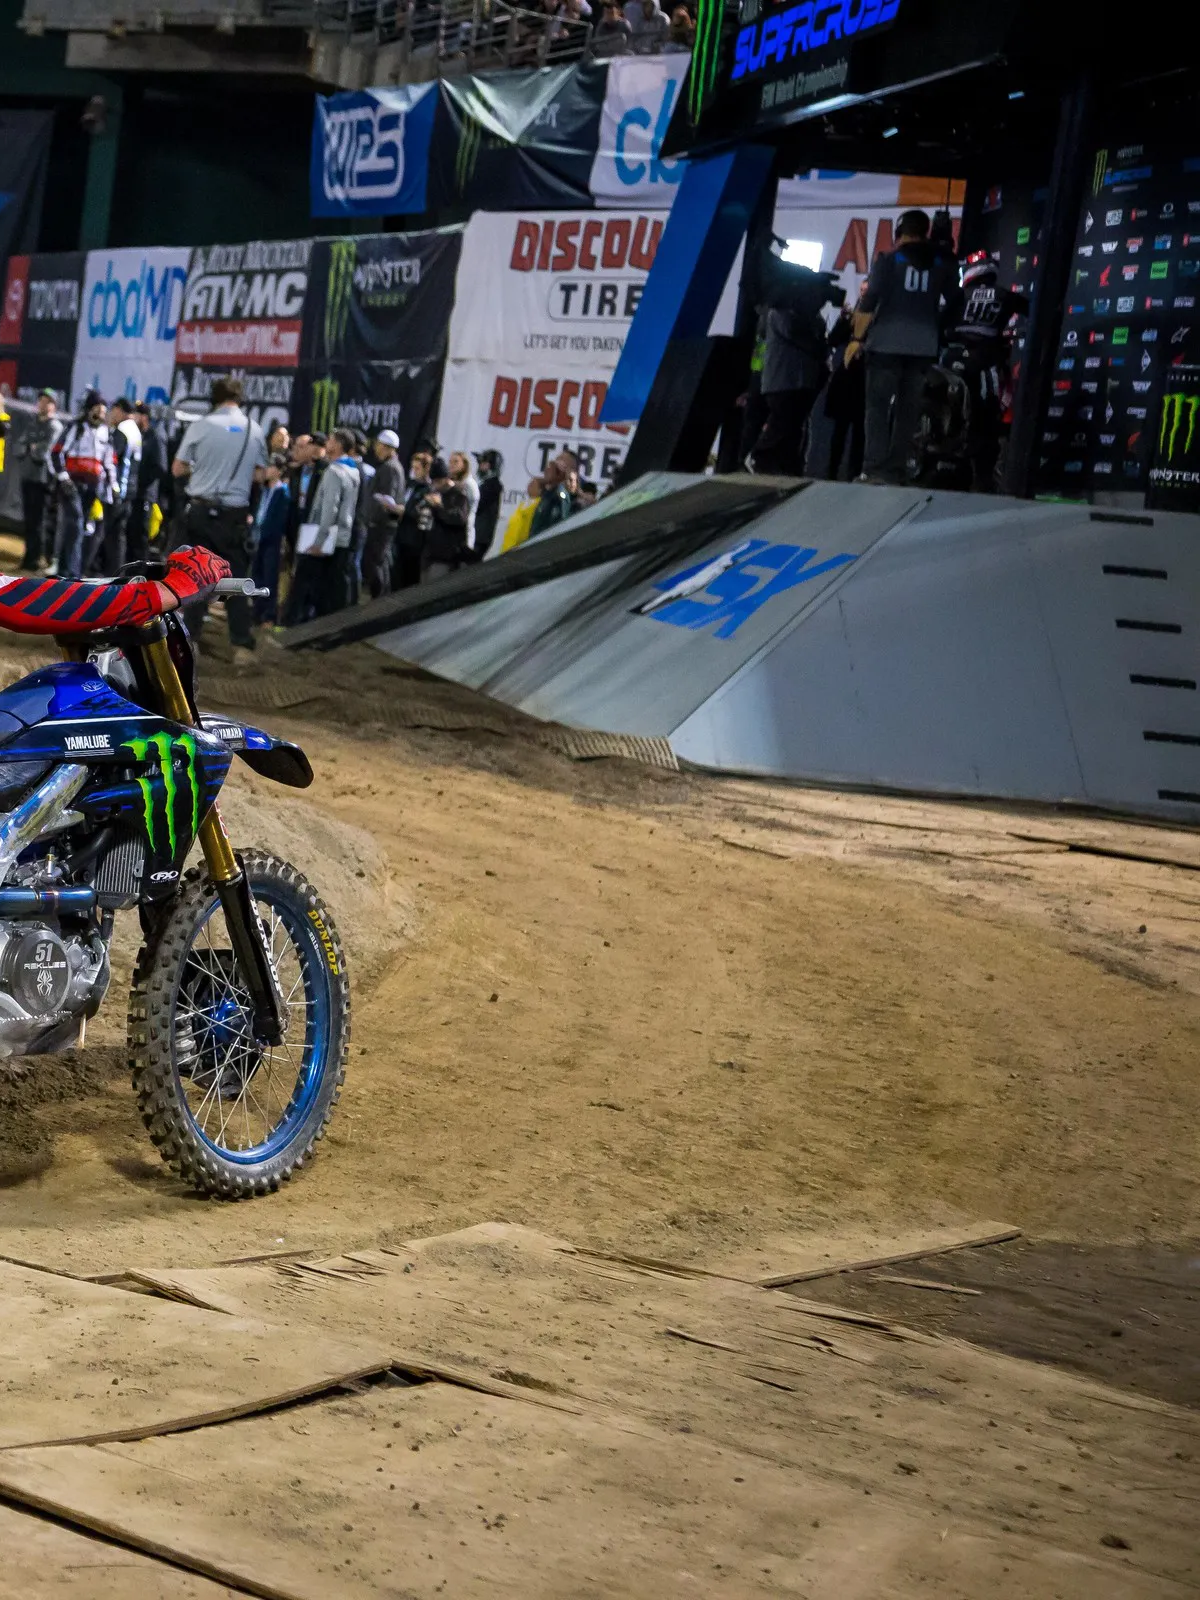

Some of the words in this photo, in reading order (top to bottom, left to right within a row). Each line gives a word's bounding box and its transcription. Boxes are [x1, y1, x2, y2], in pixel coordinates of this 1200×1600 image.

[509, 217, 664, 272] DISCOU
[89, 258, 187, 341] cbdMD
[559, 283, 644, 317] TIRE
[487, 375, 610, 430] DISCO
[64, 734, 111, 750] YAMALUBE
[219, 728, 243, 740] YAMAHA
[34, 943, 54, 962] 51
[307, 909, 340, 976] DUNLOP
